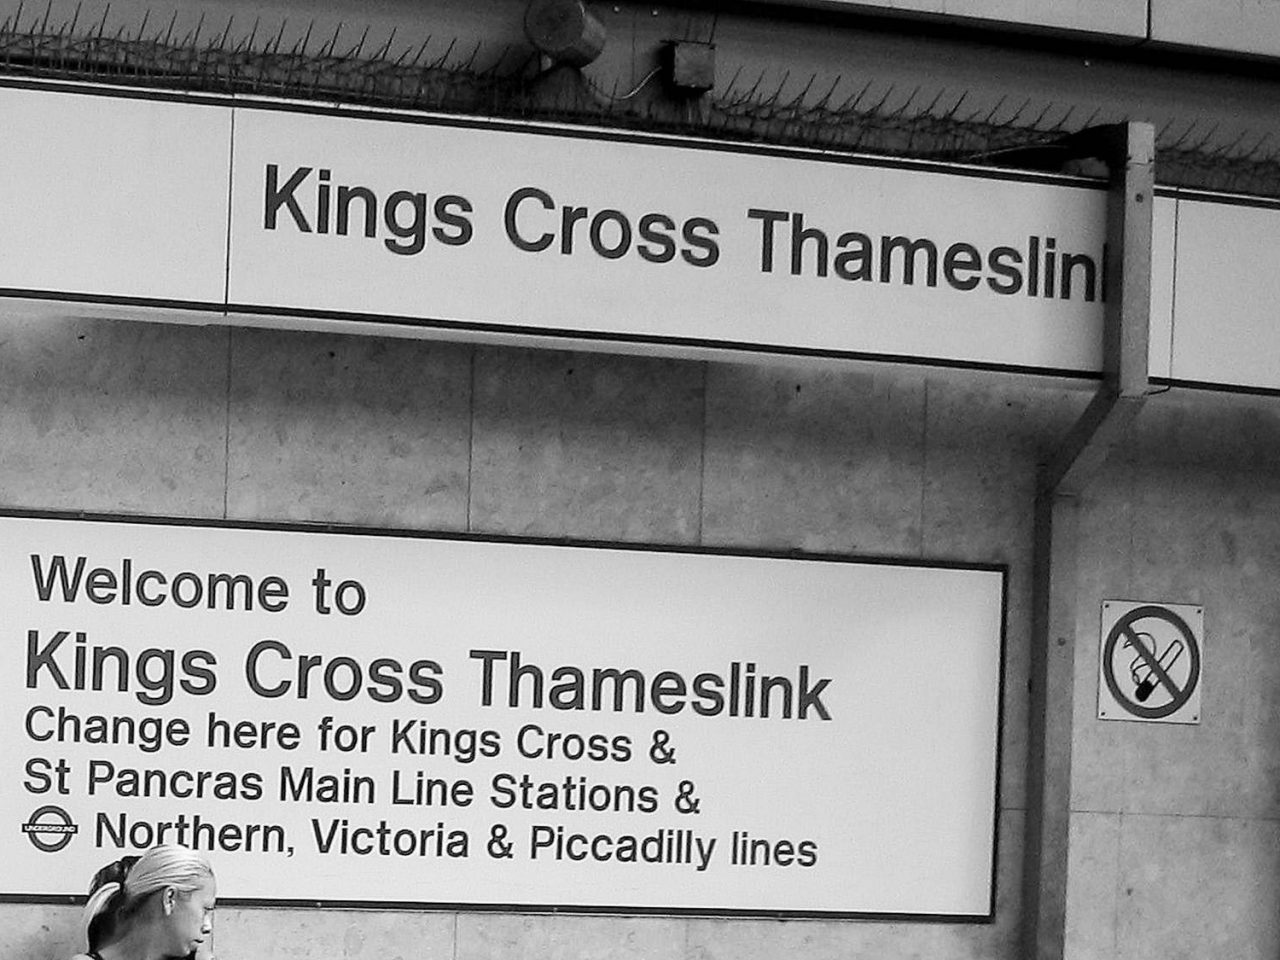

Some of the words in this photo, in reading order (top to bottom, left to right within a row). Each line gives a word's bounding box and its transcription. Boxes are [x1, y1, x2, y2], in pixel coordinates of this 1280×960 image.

[265, 164, 472, 255] Kings
[505, 188, 719, 267] Cross
[31, 555, 288, 612] Welcome
[312, 569, 365, 615] to
[27, 630, 216, 705] Kings
[246, 640, 442, 704] Cross
[470, 650, 832, 720] Thameslink
[26, 706, 189, 752] Change
[209, 712, 300, 750] here
[318, 717, 375, 752] for
[392, 720, 500, 763] Kings
[518, 725, 631, 761] Cross
[650, 730, 675, 764] &
[24, 758, 70, 794] St
[89, 760, 262, 800] Pancras
[281, 767, 374, 803] Main
[393, 771, 473, 806] Line
[491, 774, 658, 812] Stations
[675, 780, 699, 813] &
[97, 813, 293, 857] Northern,
[312, 819, 468, 857] Victoria
[488, 824, 512, 858] &
[531, 826, 716, 871] Piccadilly
[732, 832, 817, 866] lines
